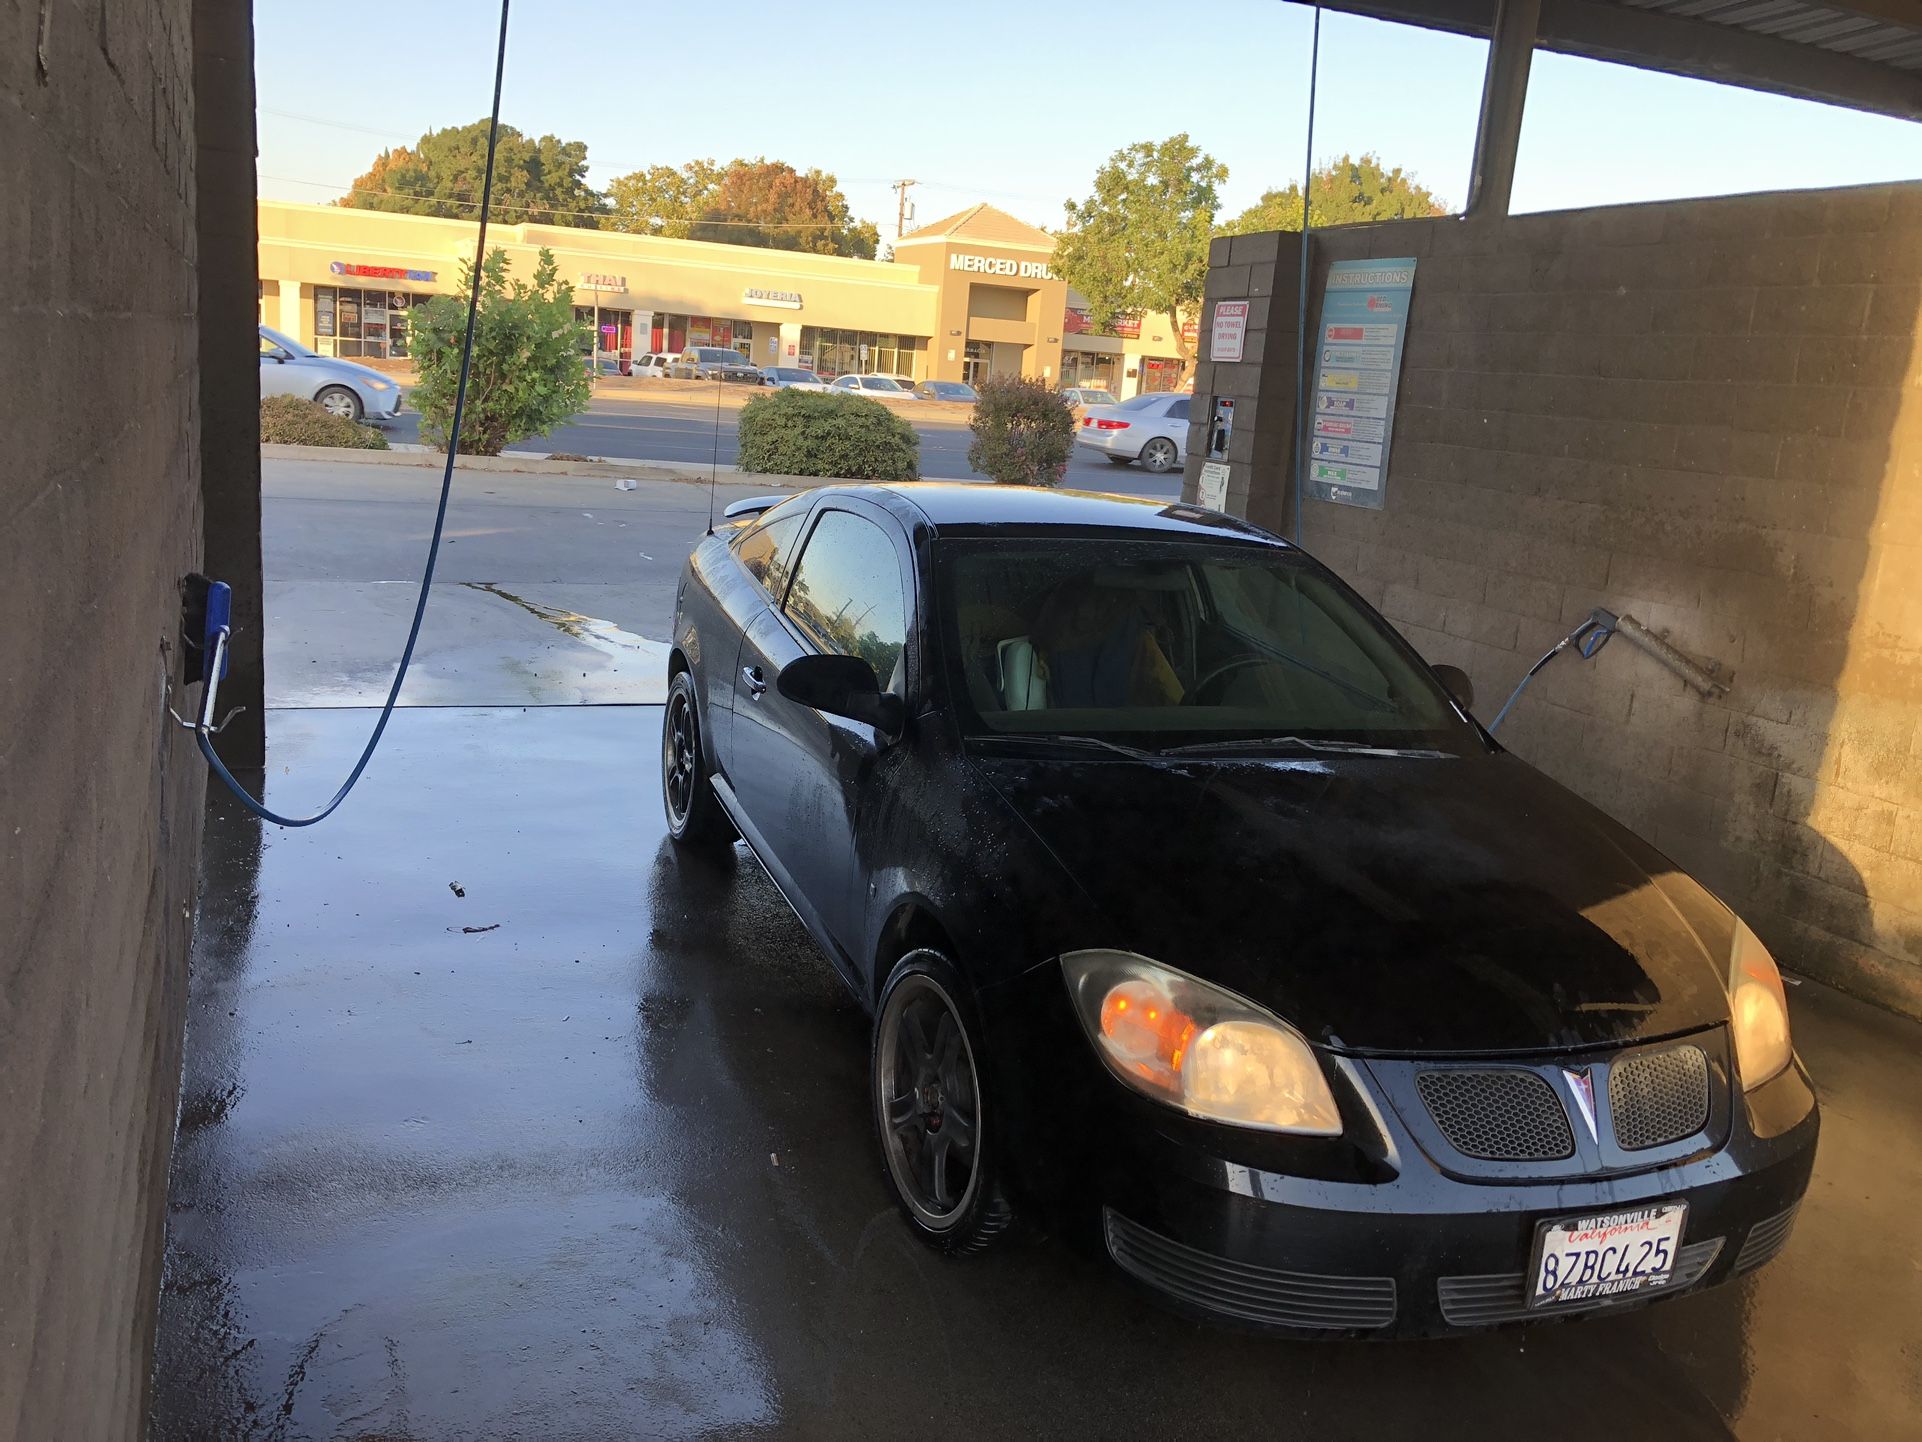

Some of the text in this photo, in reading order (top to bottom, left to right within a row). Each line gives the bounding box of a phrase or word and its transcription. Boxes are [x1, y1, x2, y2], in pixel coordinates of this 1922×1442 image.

[345, 263, 407, 280] LIBERTY
[950, 253, 1063, 281] MERCED DRU
[582, 272, 623, 287] THAI
[1332, 271, 1409, 285] INSTRUCTIONS
[744, 288, 802, 303] JOYERIA
[1219, 305, 1244, 315] PLEASE
[1216, 320, 1242, 329] NO TOWEL
[1217, 332, 1237, 341] DRYING
[1577, 1208, 1657, 1231] WATSONVILLE
[1567, 1219, 1657, 1245] California
[1542, 1236, 1671, 1293] 8ZBC425
[1558, 1285, 1595, 1302] MARTY
[1596, 1277, 1643, 1297] FRANICH
